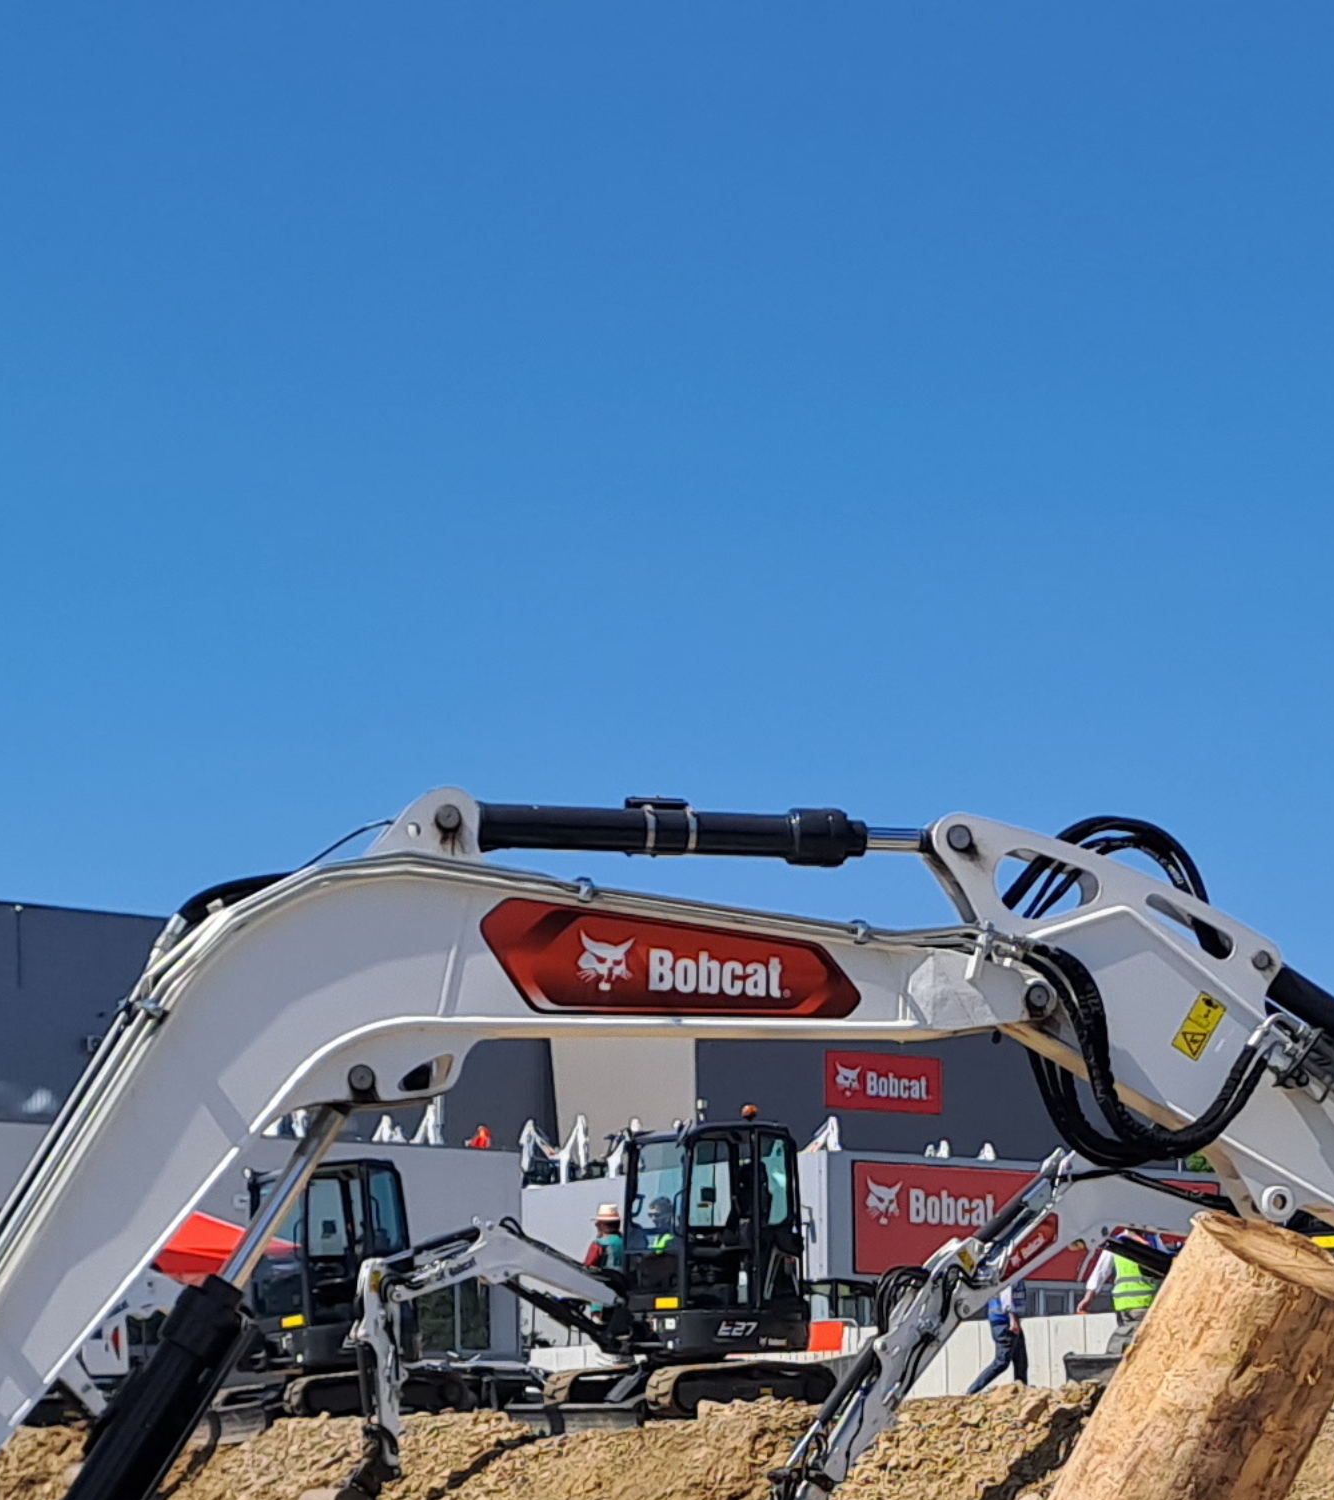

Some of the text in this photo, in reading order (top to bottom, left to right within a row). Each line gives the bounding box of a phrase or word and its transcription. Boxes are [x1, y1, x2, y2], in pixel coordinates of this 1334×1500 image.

[648, 947, 784, 999] Bobcat
[866, 1069, 928, 1100] Bobcat
[909, 1186, 995, 1228] Bobcat
[717, 1320, 759, 1336] E27
